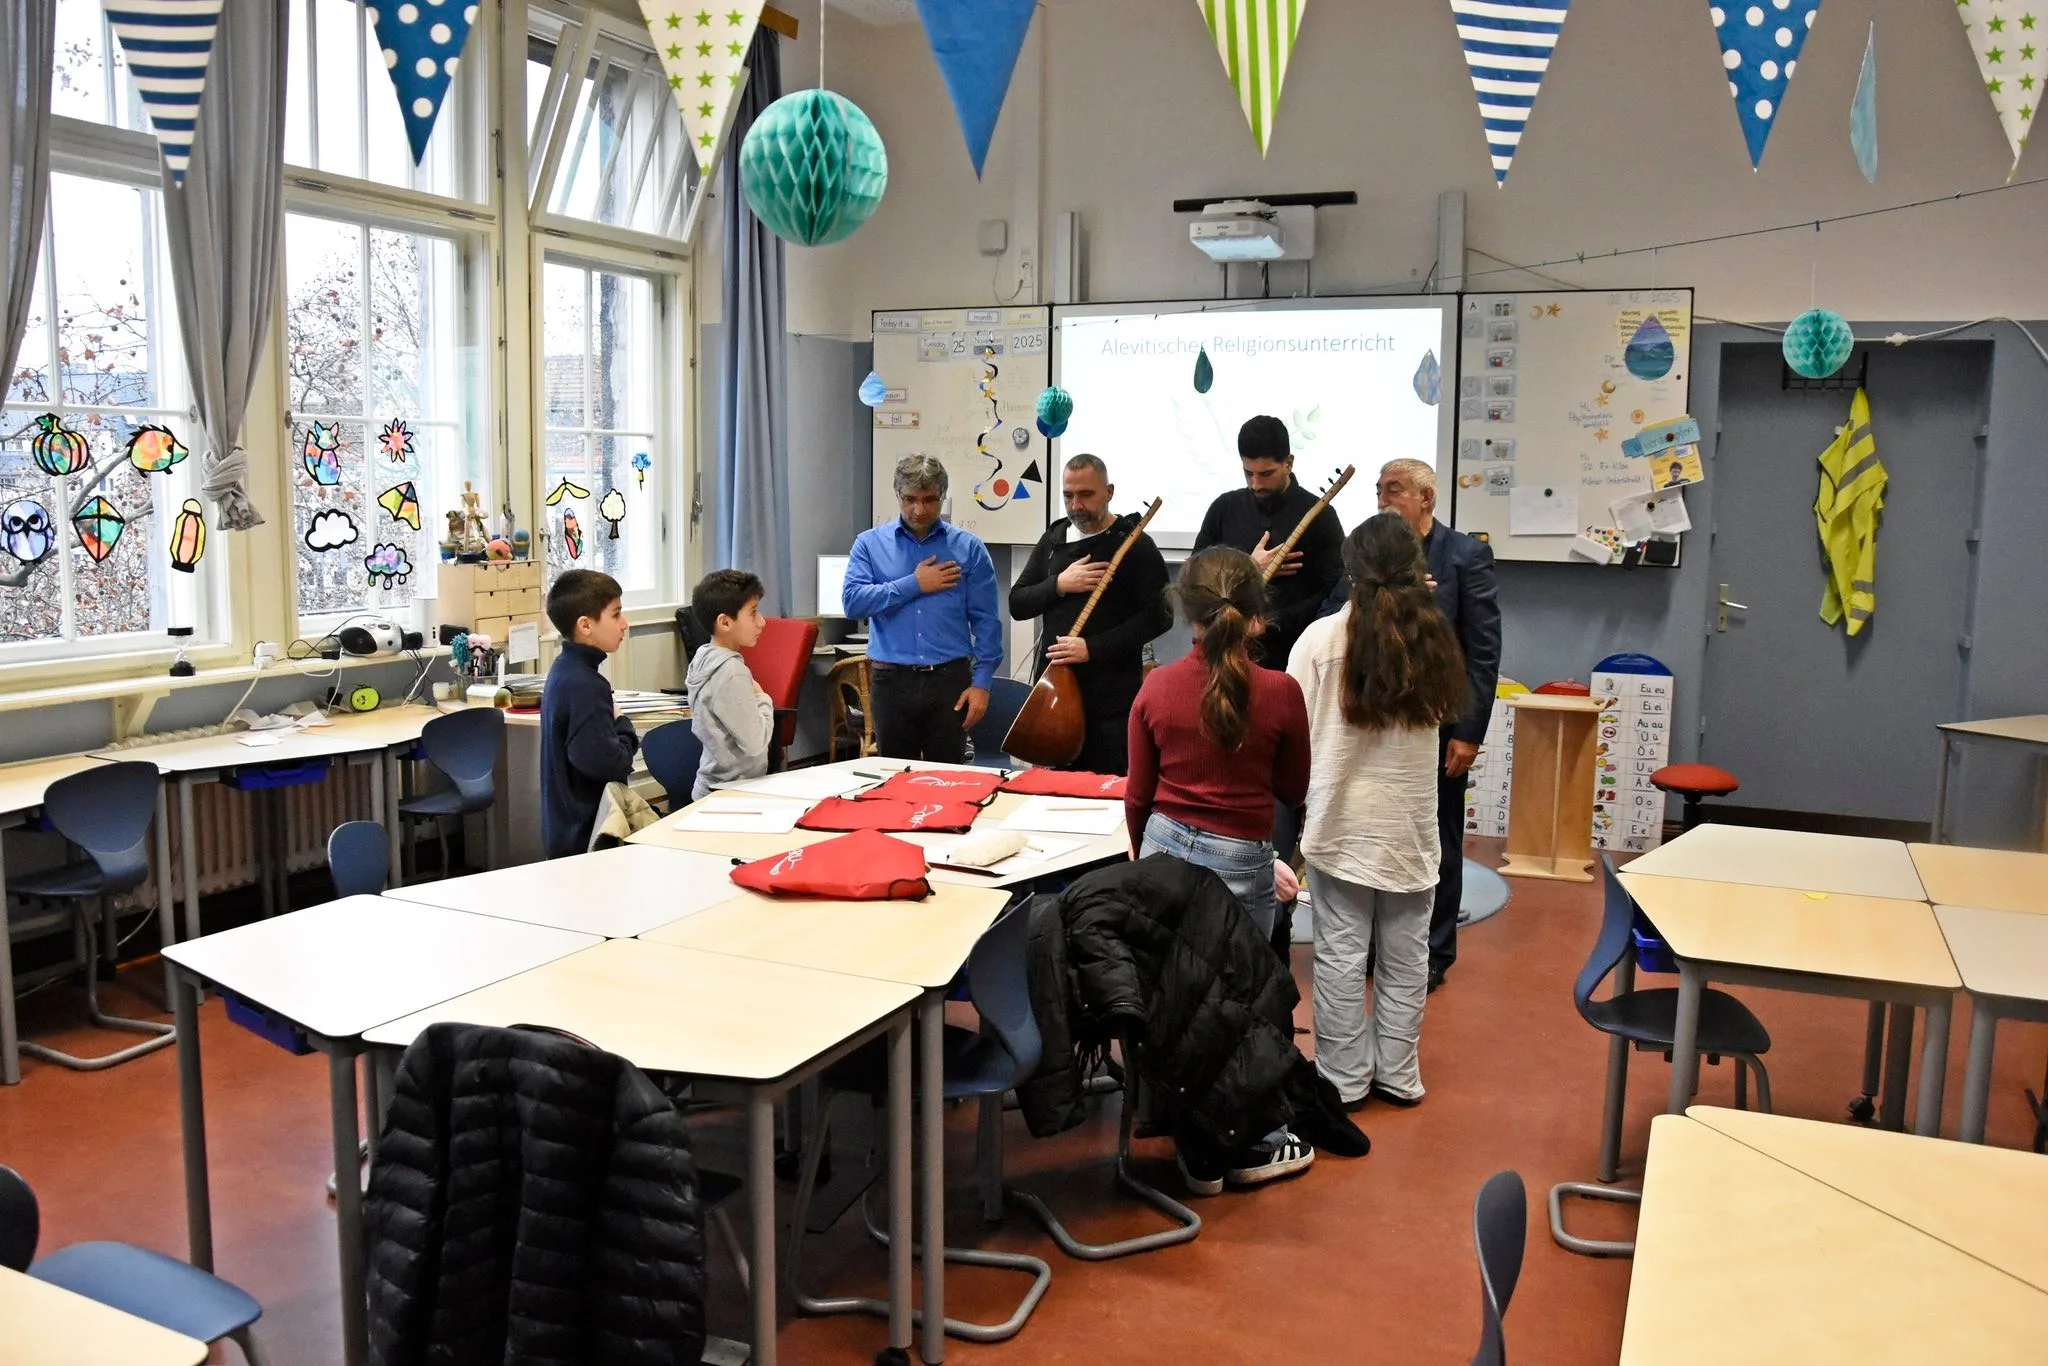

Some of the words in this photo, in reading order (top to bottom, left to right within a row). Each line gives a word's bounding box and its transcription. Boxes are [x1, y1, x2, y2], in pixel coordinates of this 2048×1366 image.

[1470, 301, 1477, 310] A
[974, 312, 993, 320] month
[1019, 313, 1032, 321] year
[879, 319, 897, 328] Today
[924, 339, 946, 349] Tuesday
[1013, 334, 1043, 349] 2025
[1213, 334, 1396, 356] Religionsunterricht
[953, 340, 965, 353] 25
[1641, 684, 1651, 693] Eu
[1643, 701, 1651, 710] Ei
[1506, 720, 1513, 728] H
[1637, 719, 1648, 728] Au
[1508, 735, 1513, 743] B
[1505, 752, 1512, 761] G
[1636, 762, 1644, 771] U
[1507, 767, 1512, 776] F
[1502, 782, 1508, 790] R
[1500, 795, 1507, 804] S
[1635, 796, 1643, 806] O
[1498, 811, 1505, 820] D
[1498, 825, 1505, 834] M
[1632, 825, 1637, 834] E
[1627, 840, 1633, 849] A
